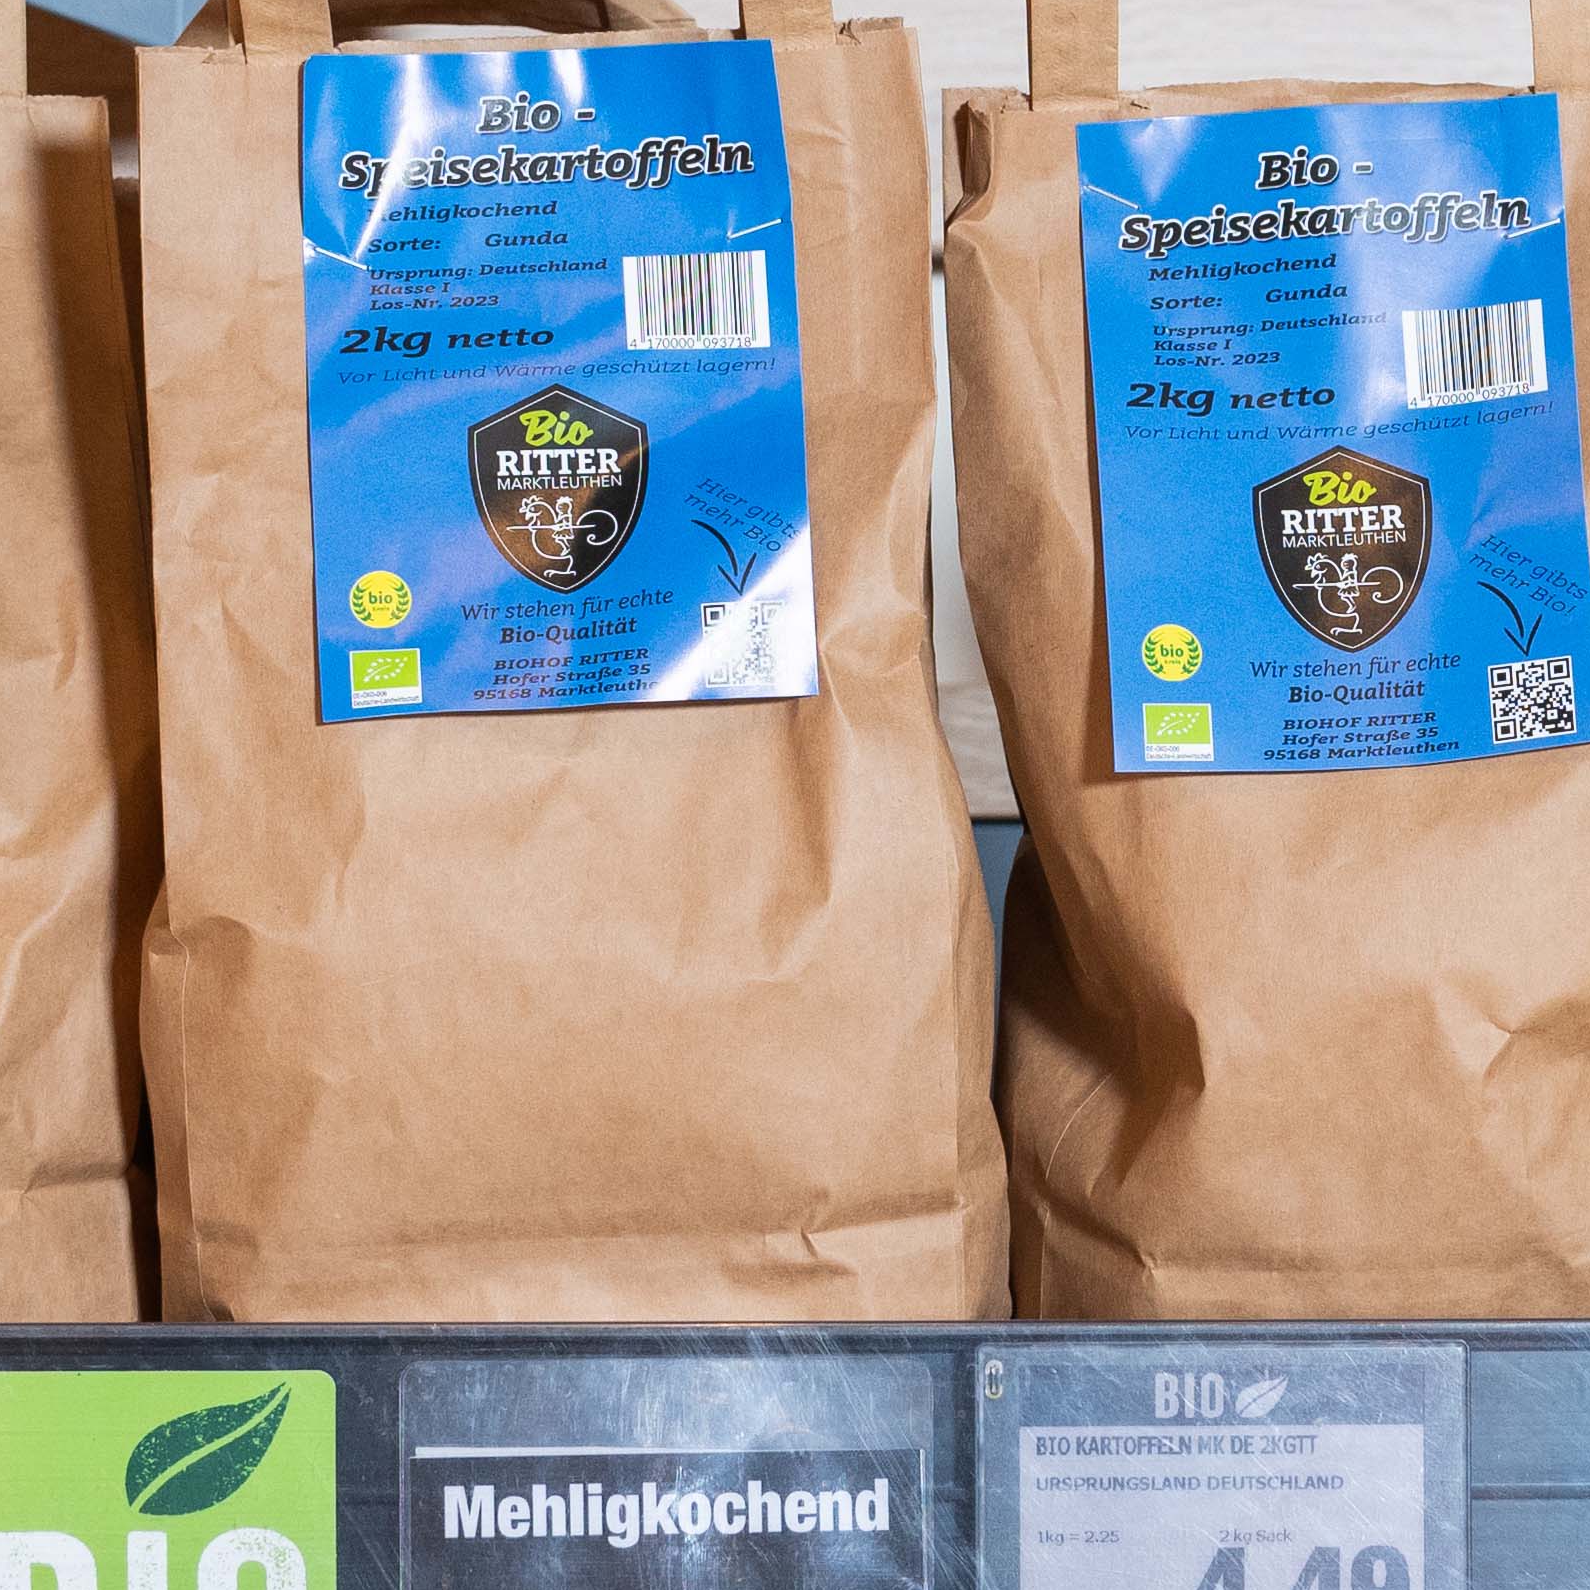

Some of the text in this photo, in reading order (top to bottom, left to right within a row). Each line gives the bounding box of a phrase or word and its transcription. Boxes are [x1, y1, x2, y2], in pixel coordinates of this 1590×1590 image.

[477, 91, 560, 135] Bio
[339, 134, 754, 197] Speisekartoffeln
[1255, 145, 1339, 190] Bio
[1119, 189, 1531, 259] Speisekartoffeln
[369, 230, 568, 253] Sorte: Gunda
[1148, 253, 1337, 282] Mehligkochend
[1150, 284, 1348, 310] Sorte: Gunda
[339, 326, 555, 357] 2kg netto
[1126, 382, 1335, 417] 2kg netto
[519, 410, 593, 447] Bio
[496, 448, 621, 476] RITTER
[497, 474, 622, 490] MARKTLEUTHEN
[1303, 471, 1377, 507] Bio
[1281, 504, 1405, 534] RITTER
[1282, 530, 1407, 548] MARKTLEUTHEN
[499, 617, 637, 646] Bio-Qualität
[1287, 680, 1425, 705] Bio-Qualität
[1155, 1372, 1224, 1419] BIO
[1036, 1437, 1070, 1455] BIO
[1076, 1436, 1191, 1455] KARTOFFELN
[1198, 1436, 1224, 1455] MK
[1230, 1435, 1254, 1455] DE
[1036, 1475, 1344, 1491] URSPRUNGSLAND DEUTSCHLAND
[443, 1478, 889, 1548] Mehligkochend
[1038, 1530, 1064, 1545] 1kg
[1084, 1530, 1120, 1543] 2.25
[1233, 1530, 1252, 1544] kg
[1256, 1529, 1293, 1542] Sack
